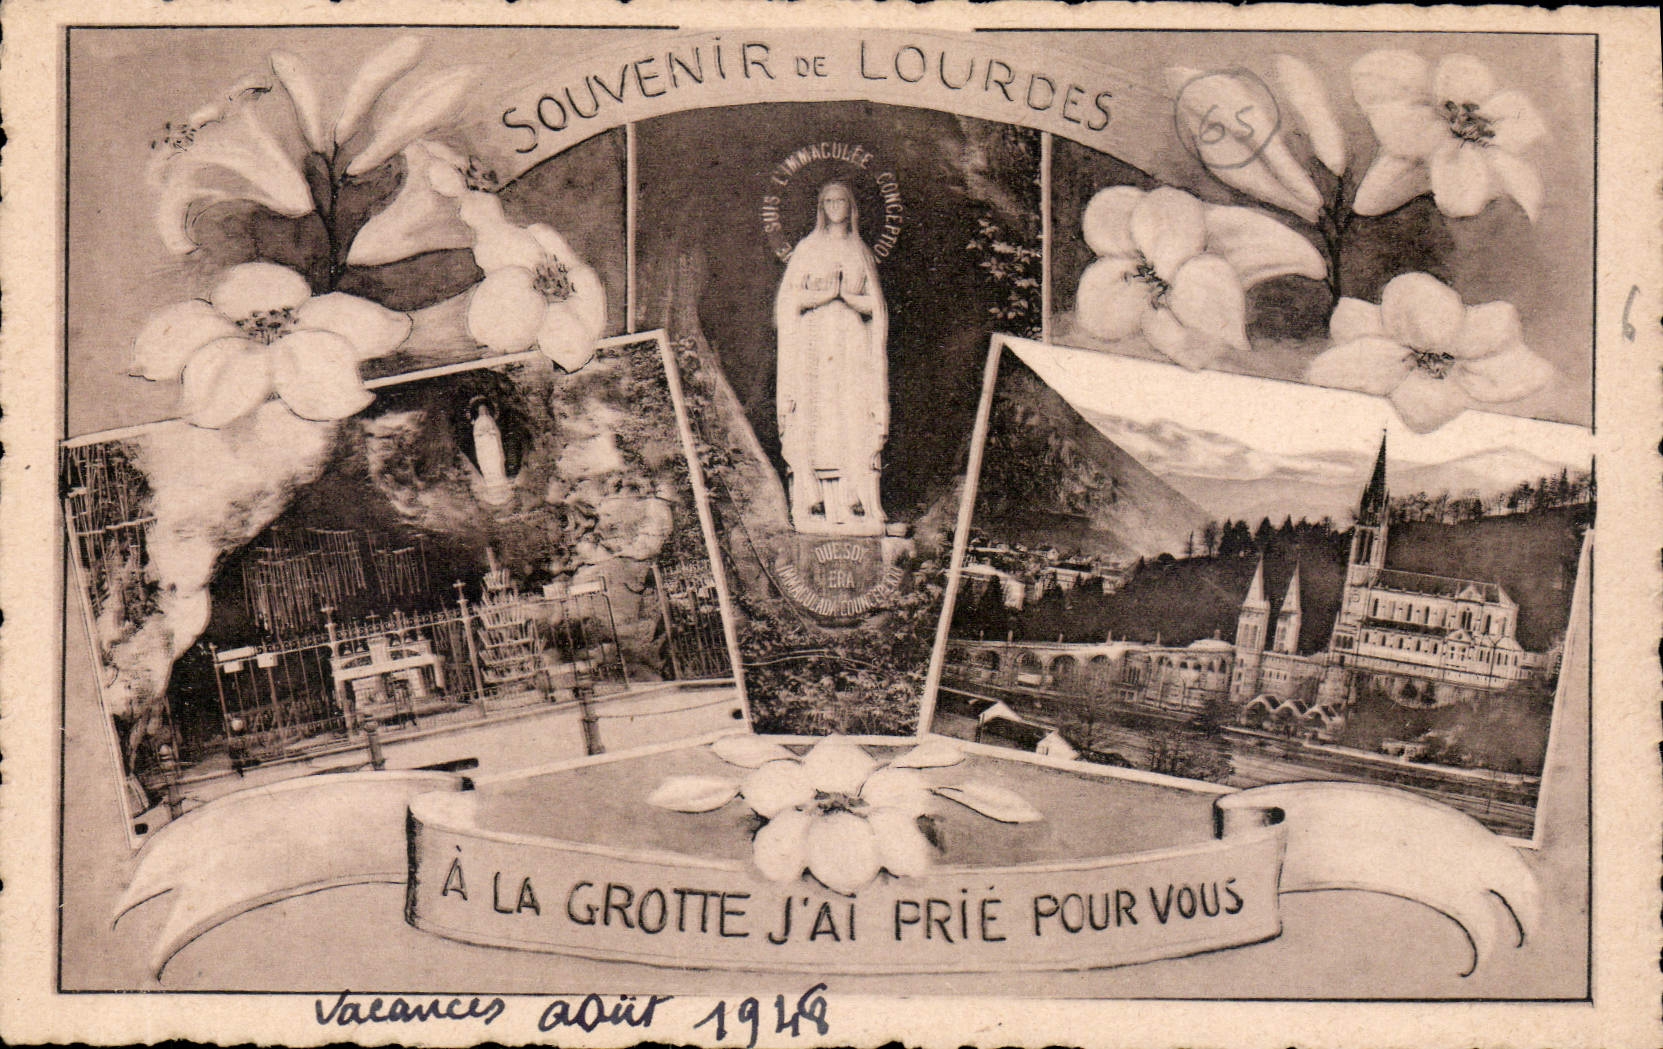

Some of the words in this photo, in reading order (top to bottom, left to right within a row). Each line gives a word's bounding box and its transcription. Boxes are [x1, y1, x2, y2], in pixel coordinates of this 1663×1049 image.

[501, 37, 776, 153] SOUVENIR
[795, 56, 826, 79] DE
[859, 39, 1113, 133] LOURDES
[762, 195, 782, 233] SUIS
[873, 172, 904, 264] CONCEPTIO
[829, 570, 855, 589] ERA
[442, 845, 467, 901] À
[493, 872, 541, 916] LA
[567, 882, 751, 935] GROTTE
[768, 893, 857, 946] J'AI
[895, 885, 1006, 944] PRIÉ
[1034, 889, 1138, 937] POUR
[1149, 878, 1244, 924] VOUS
